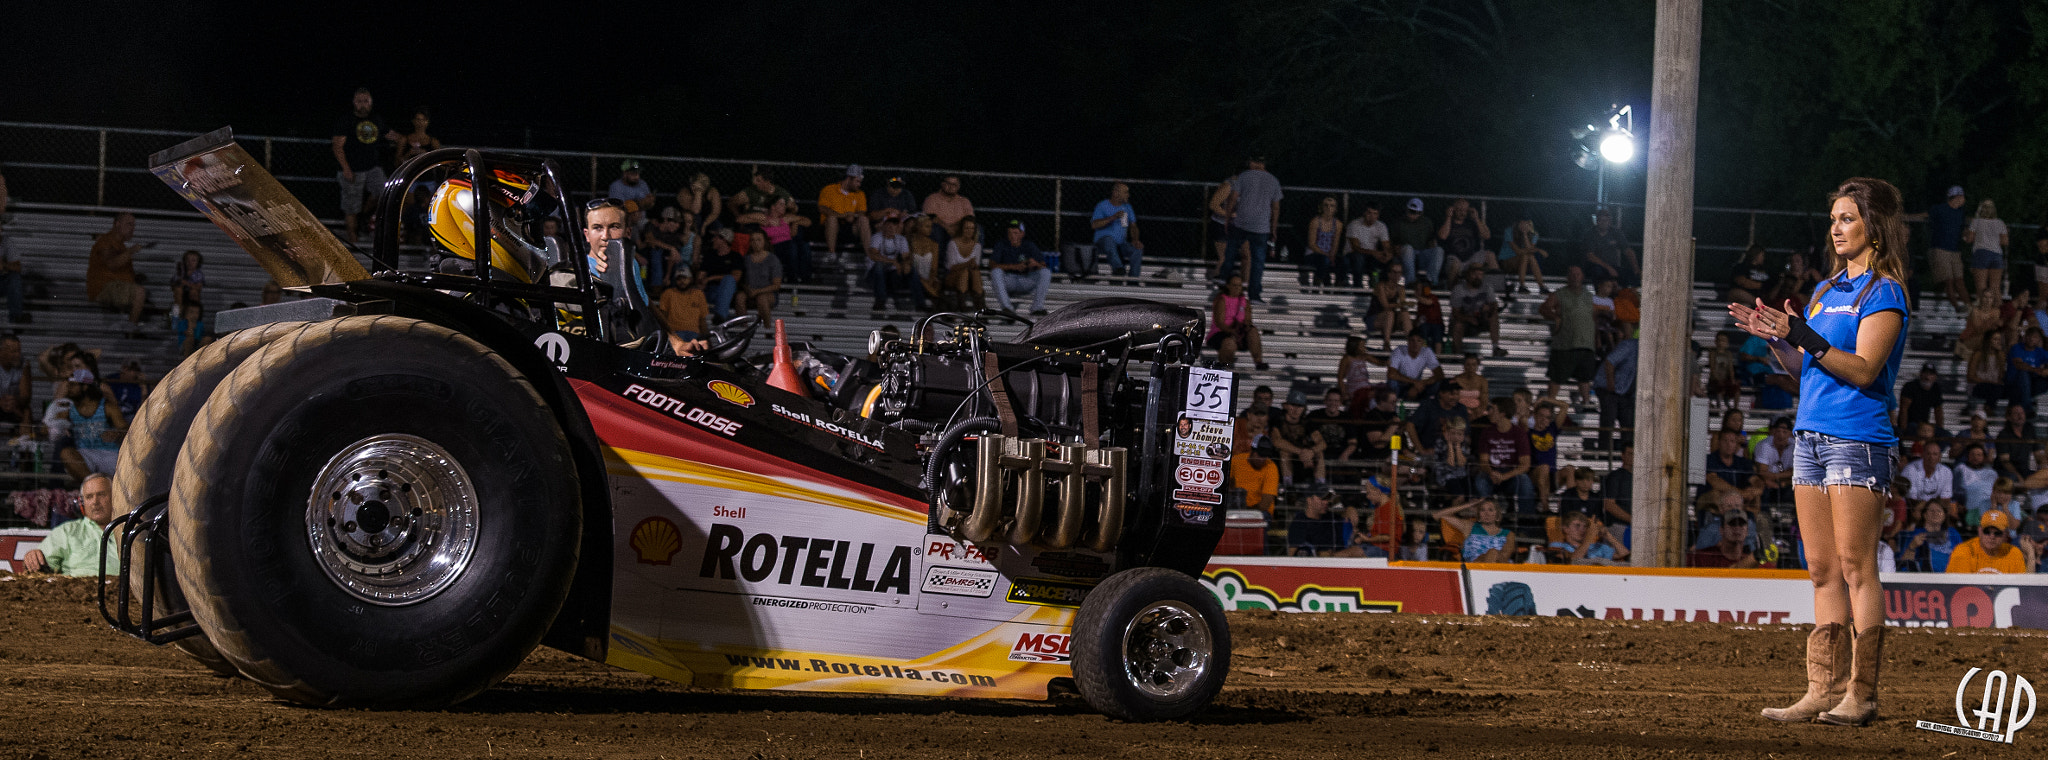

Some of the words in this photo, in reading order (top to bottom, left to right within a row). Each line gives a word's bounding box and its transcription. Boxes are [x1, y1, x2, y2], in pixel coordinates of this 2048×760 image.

[1202, 373, 1220, 382] NTPA
[1190, 382, 1229, 409] 55
[623, 383, 743, 437] FOOTLOOSE
[771, 403, 811, 423] Shell
[815, 418, 885, 450] ROTELLA
[1200, 425, 1223, 435] Steve
[1192, 431, 1231, 444] Thompson
[713, 505, 746, 519] Shell
[945, 578, 975, 586] BMRS
[1884, 589, 1948, 620] WER
[725, 653, 997, 687] www.Rotella.com
